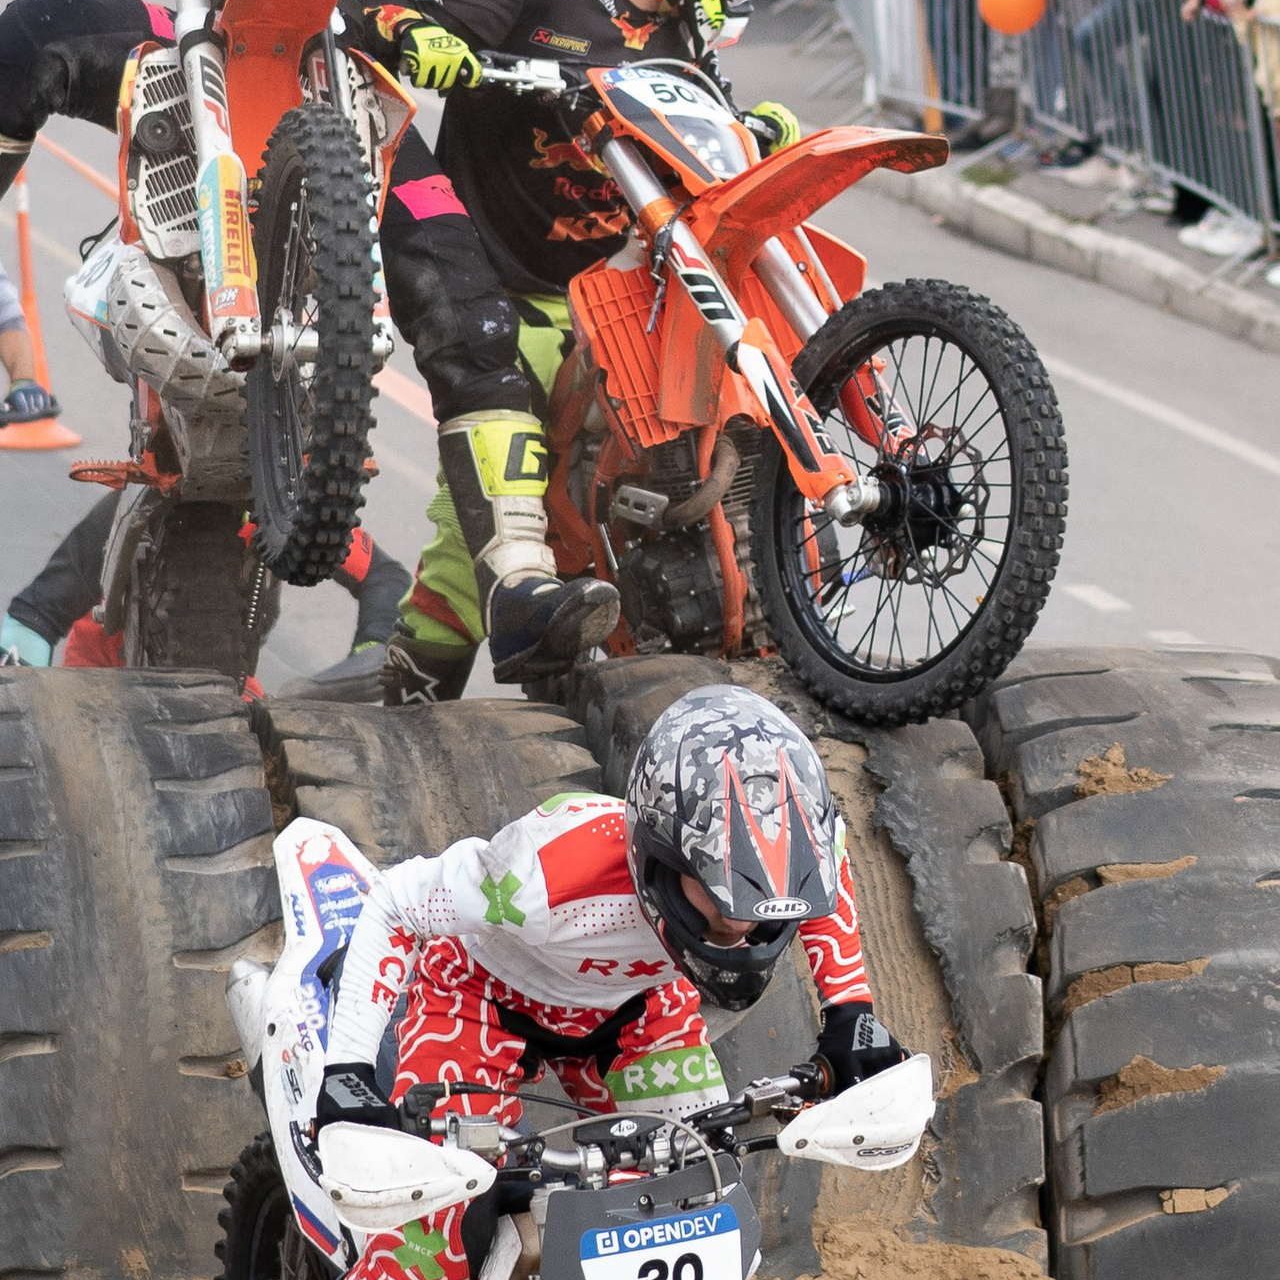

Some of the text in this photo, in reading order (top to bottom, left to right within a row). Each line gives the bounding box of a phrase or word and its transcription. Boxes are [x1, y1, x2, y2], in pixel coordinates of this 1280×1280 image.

[224, 188, 244, 275] PIRELLI
[763, 903, 803, 914] HJC
[294, 983, 327, 1031] 200
[297, 1021, 314, 1052] EXC
[623, 1214, 719, 1249] OPENDEV
